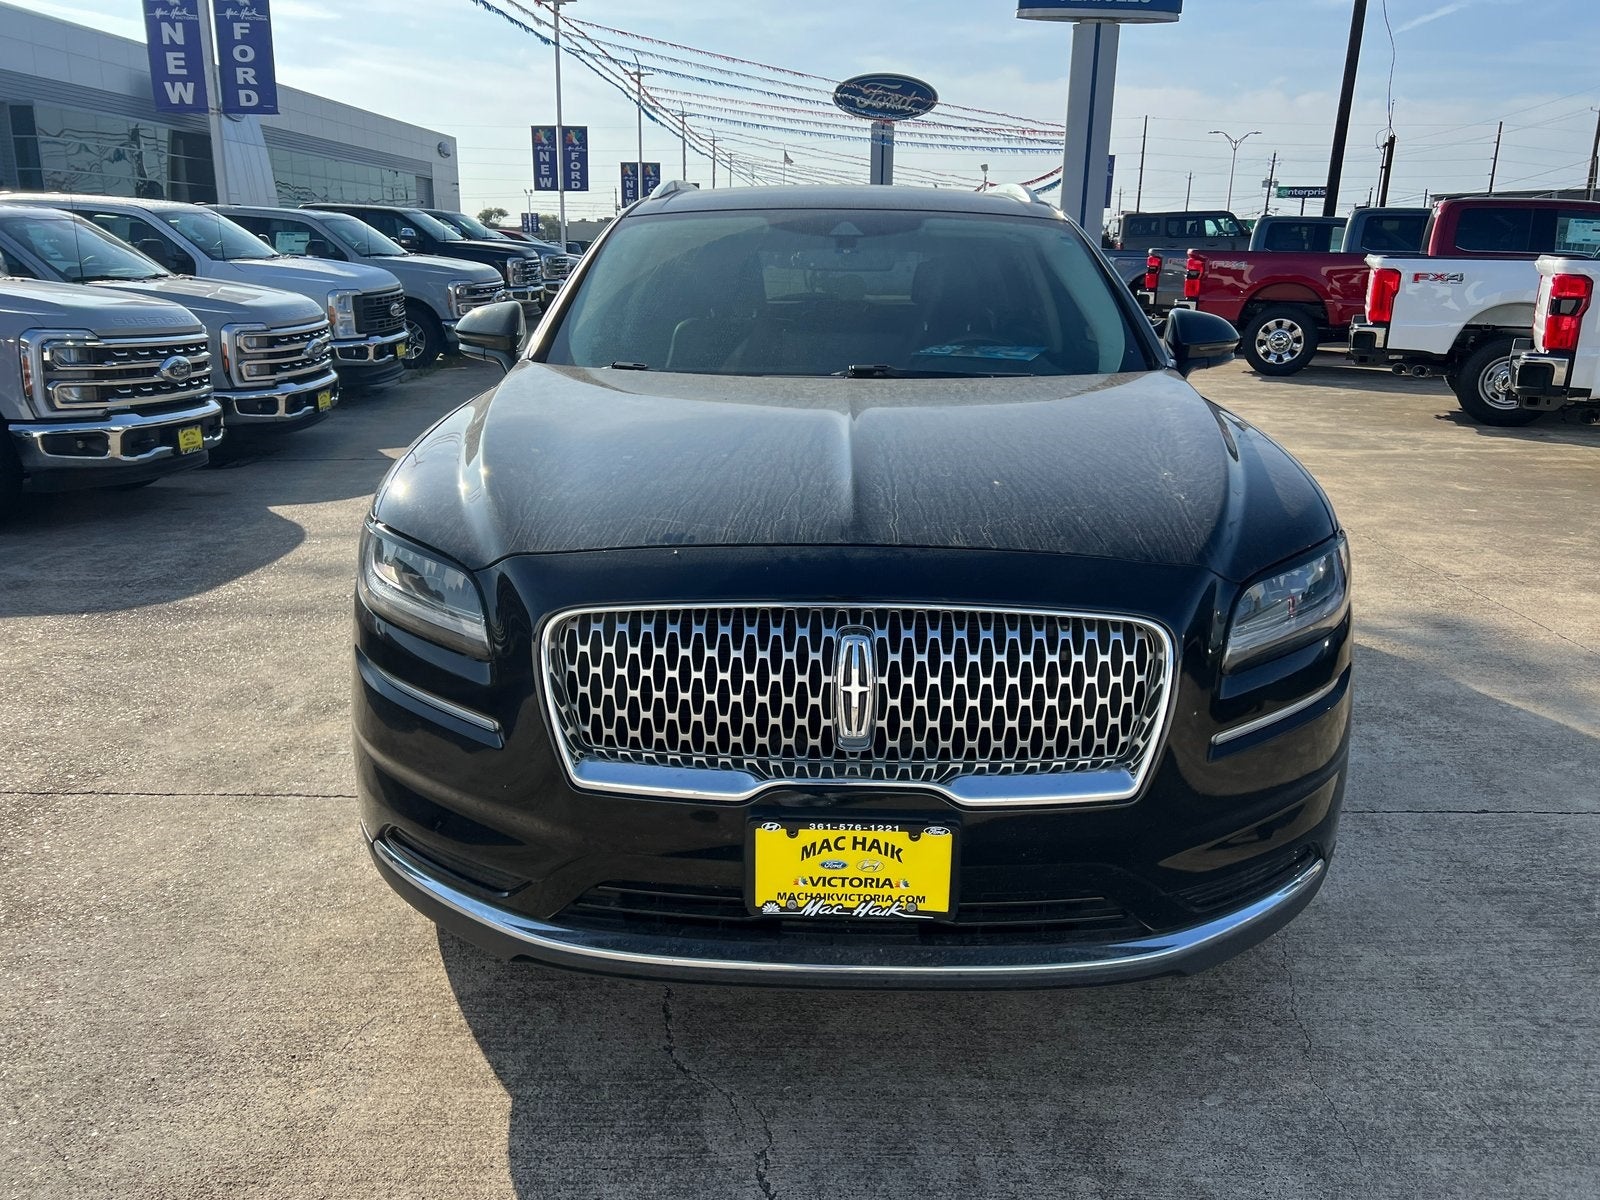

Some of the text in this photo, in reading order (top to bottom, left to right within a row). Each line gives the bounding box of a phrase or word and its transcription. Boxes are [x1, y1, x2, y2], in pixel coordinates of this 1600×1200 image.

[160, 22, 195, 104] NEW
[232, 22, 259, 107] FORD
[856, 82, 915, 109] Ford
[539, 151, 553, 188] NEW
[570, 152, 581, 189] FORD
[1281, 188, 1326, 197] enterpris
[1412, 272, 1464, 283] FX4
[809, 823, 900, 833] 361-576-1221
[928, 827, 946, 836] Ford
[800, 835, 904, 864] MAC HAIK
[822, 861, 845, 869] Ford
[808, 876, 895, 889] VICTORIA
[800, 899, 851, 917] Mac
